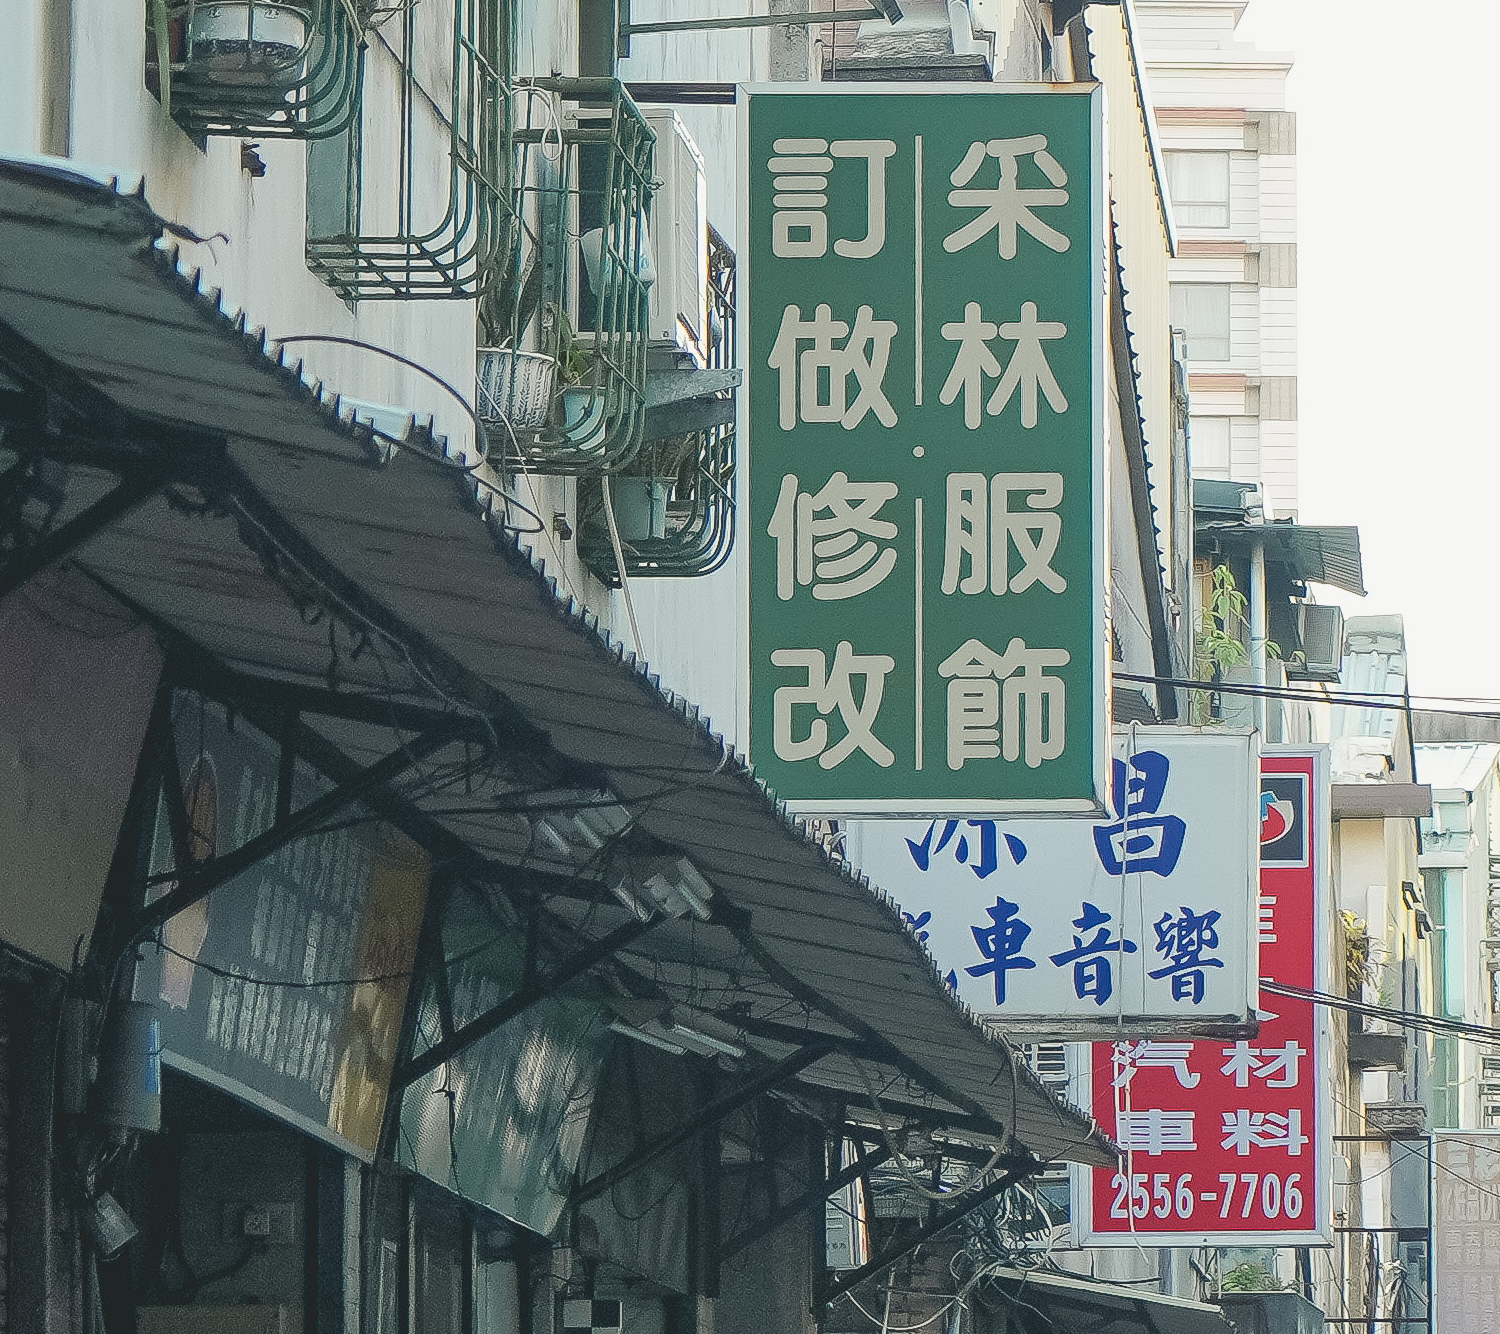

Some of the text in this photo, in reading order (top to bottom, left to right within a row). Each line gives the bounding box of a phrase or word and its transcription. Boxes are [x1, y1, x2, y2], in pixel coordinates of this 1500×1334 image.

[901, 895, 1224, 1006] 車音響
[1220, 1040, 1309, 1156] 材料
[1110, 1172, 1304, 1220] 2556-7706
